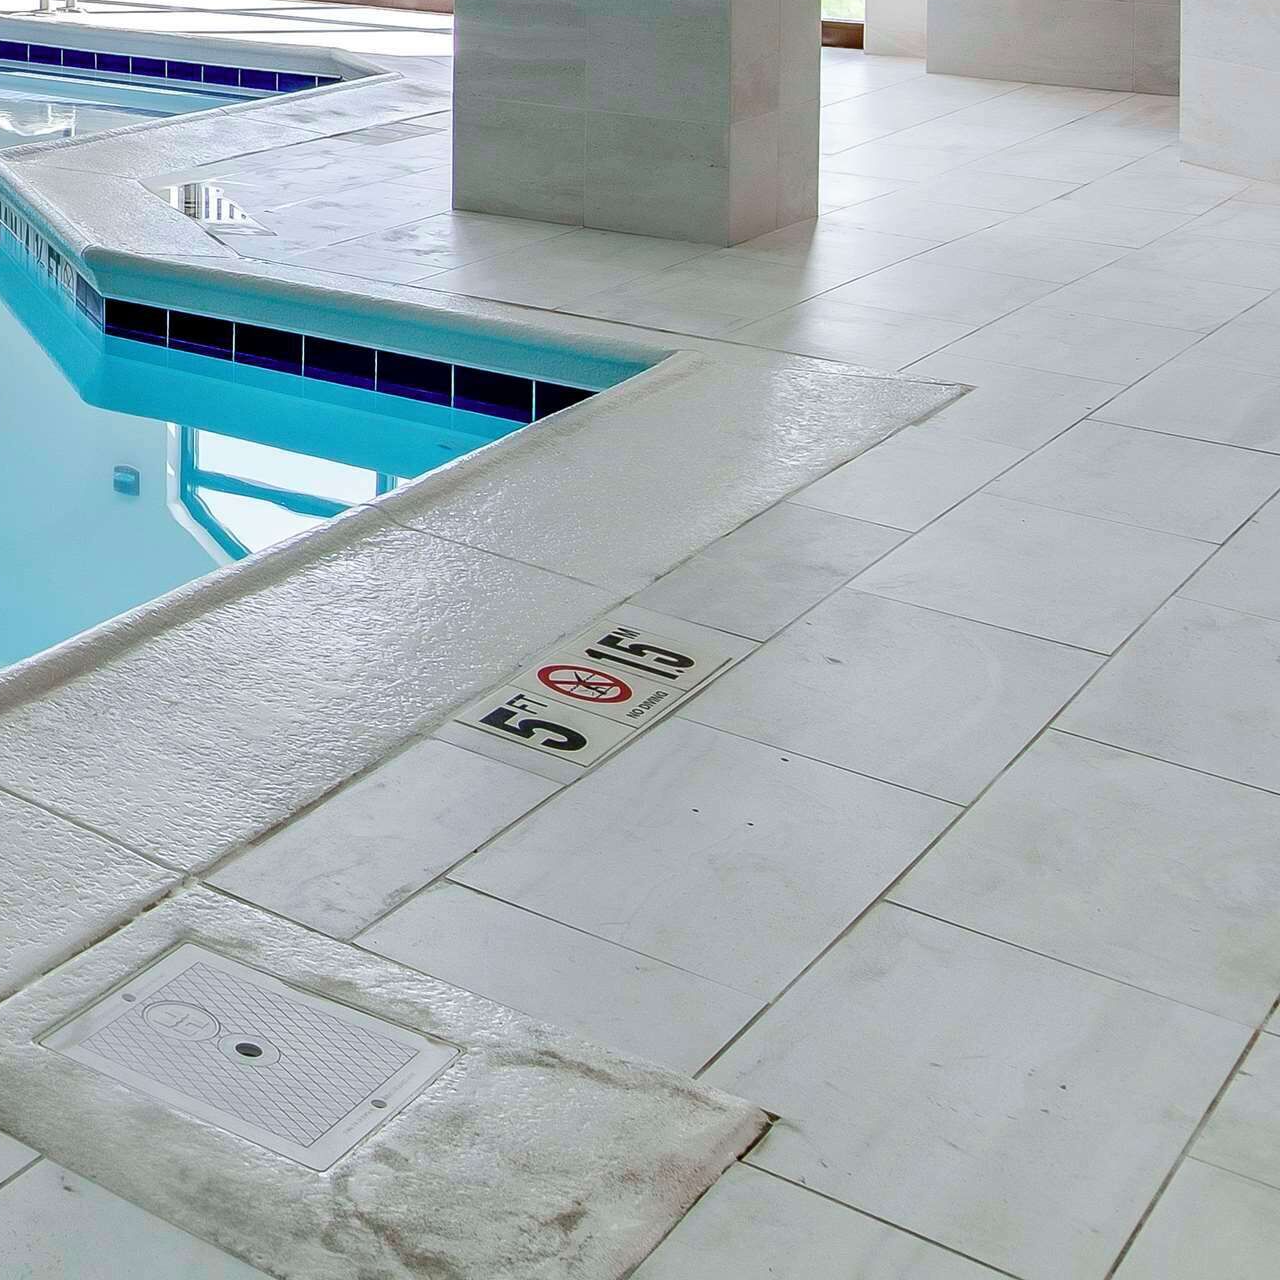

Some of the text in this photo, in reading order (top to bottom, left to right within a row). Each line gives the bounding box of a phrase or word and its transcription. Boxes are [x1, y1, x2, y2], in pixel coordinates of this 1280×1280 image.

[612, 627, 641, 640] M
[625, 690, 670, 720] NO DIVING
[479, 693, 588, 752] 5 FT
